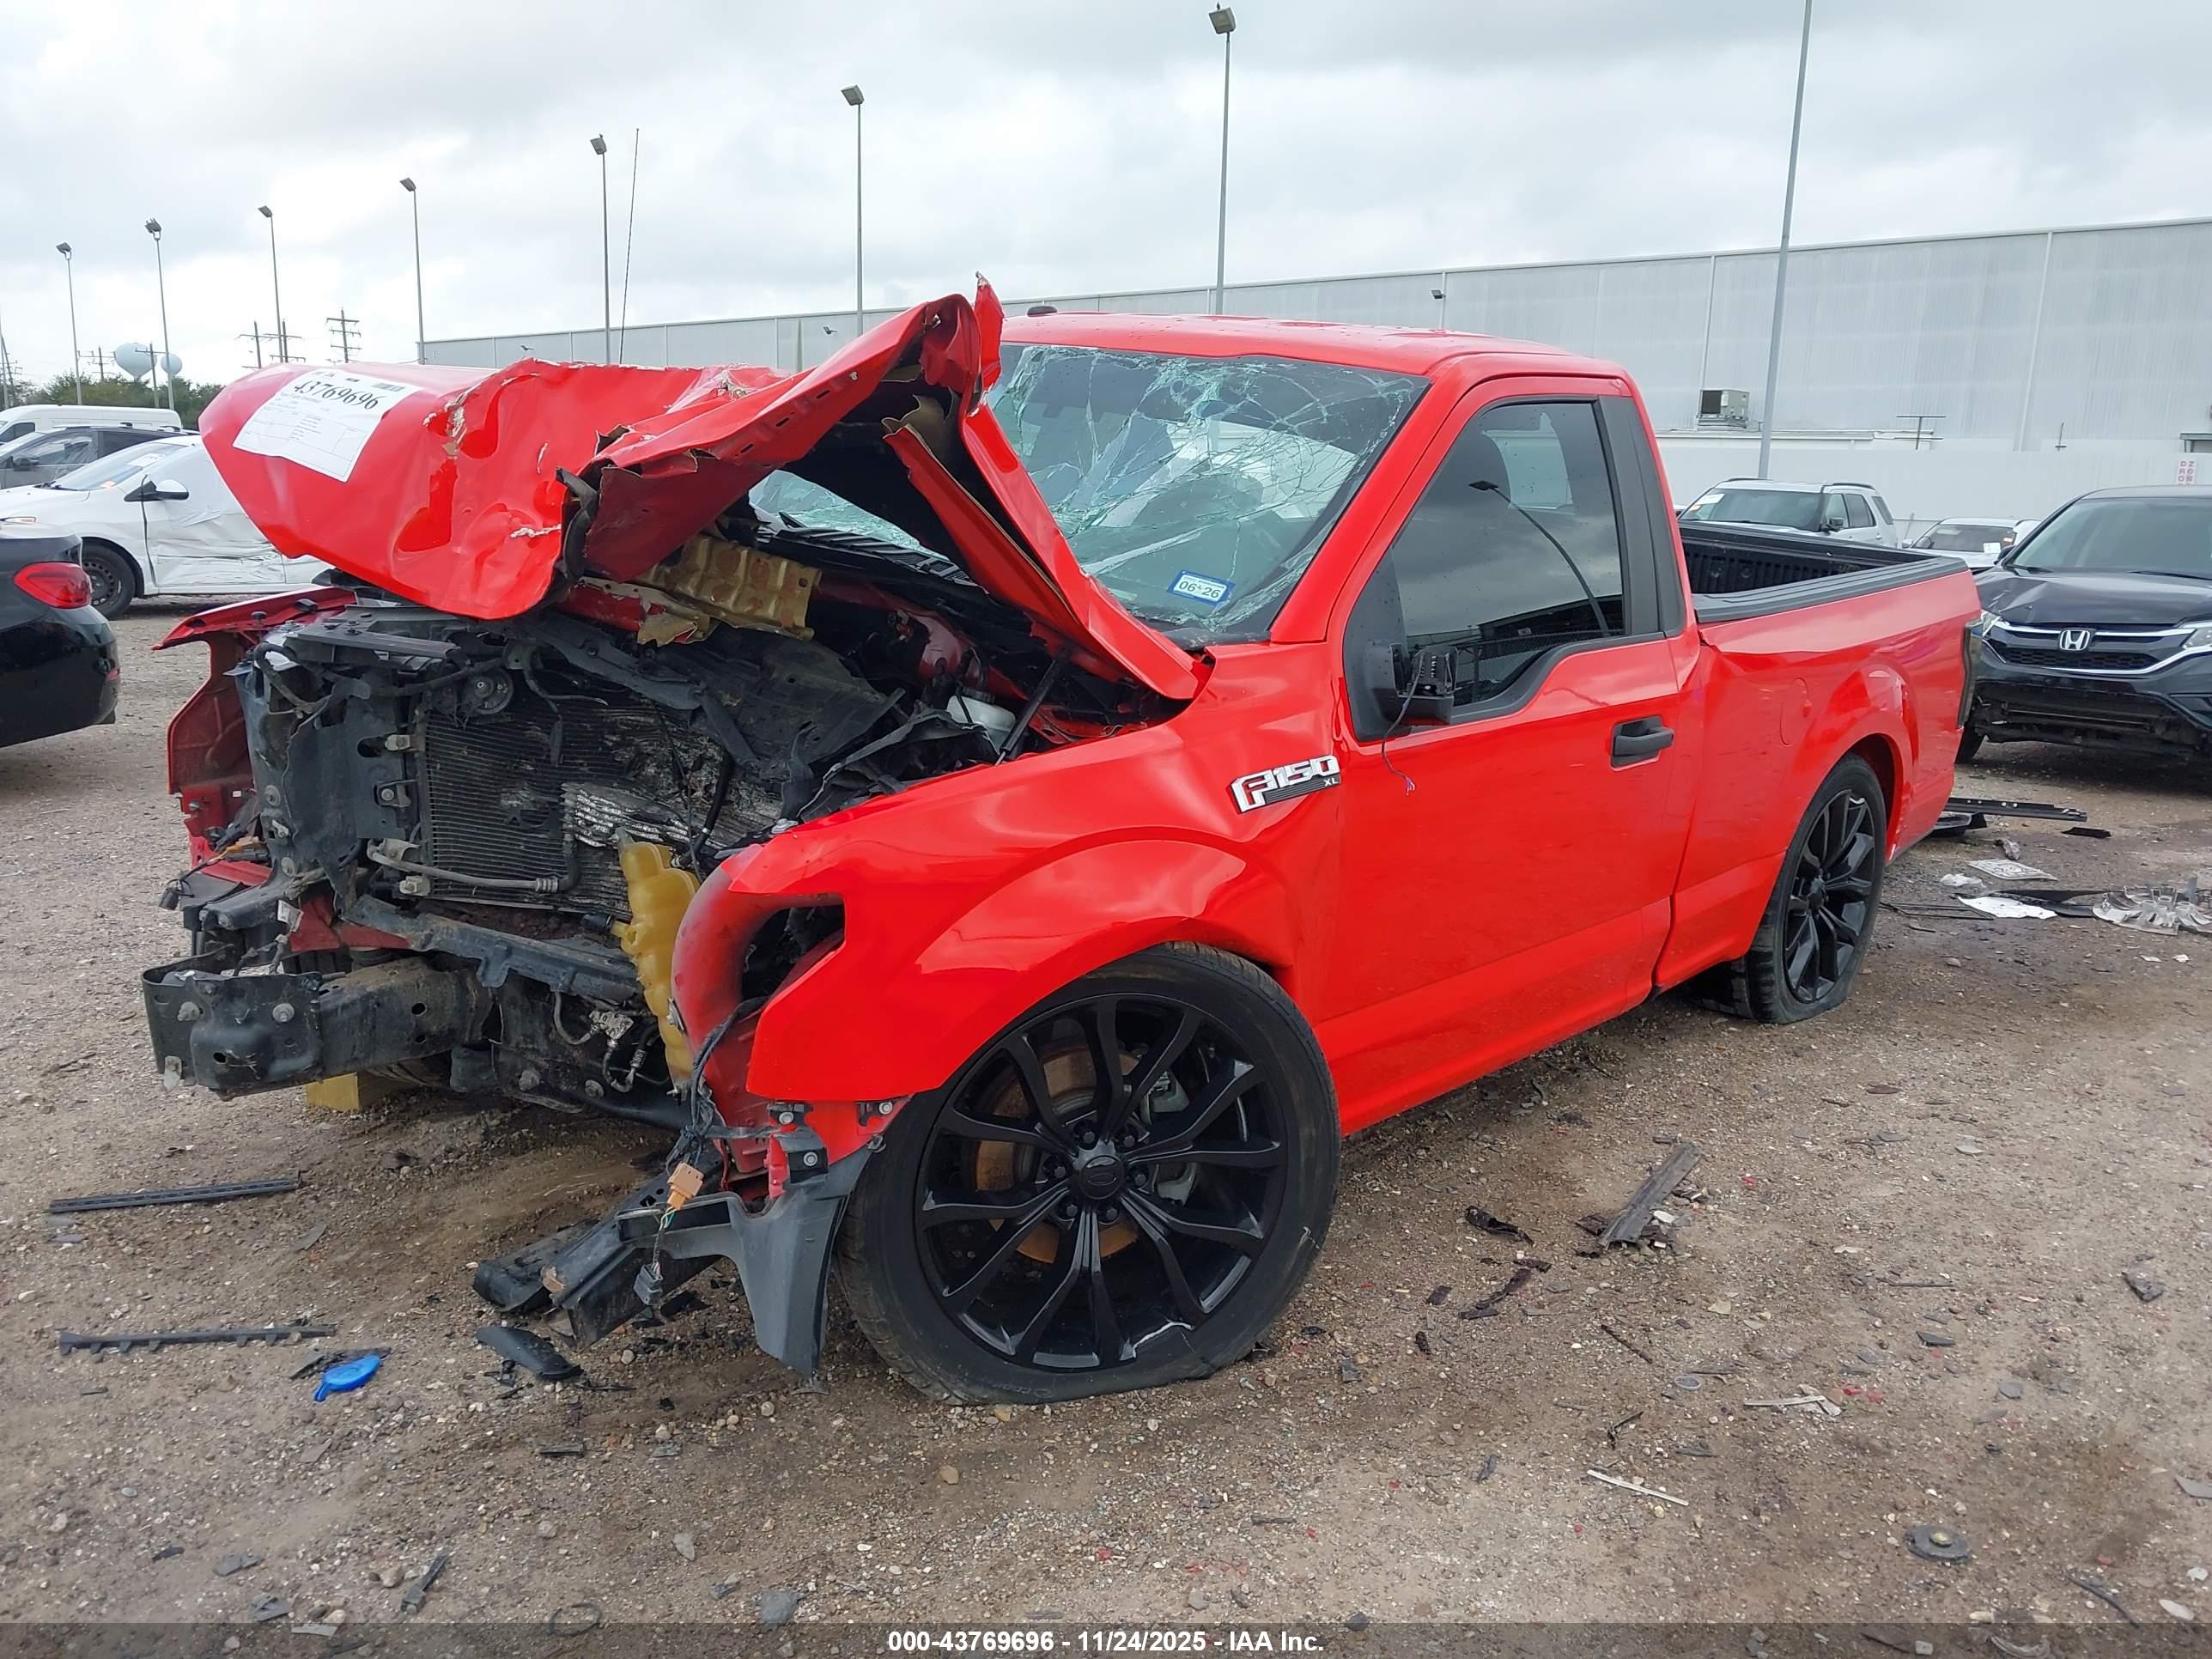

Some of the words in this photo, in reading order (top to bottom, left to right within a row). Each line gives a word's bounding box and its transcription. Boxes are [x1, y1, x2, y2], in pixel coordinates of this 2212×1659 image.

[294, 380, 386, 410] 43769696
[1179, 580, 1197, 592] 06
[1202, 586, 1221, 599] 26
[1324, 777, 1339, 787] XL
